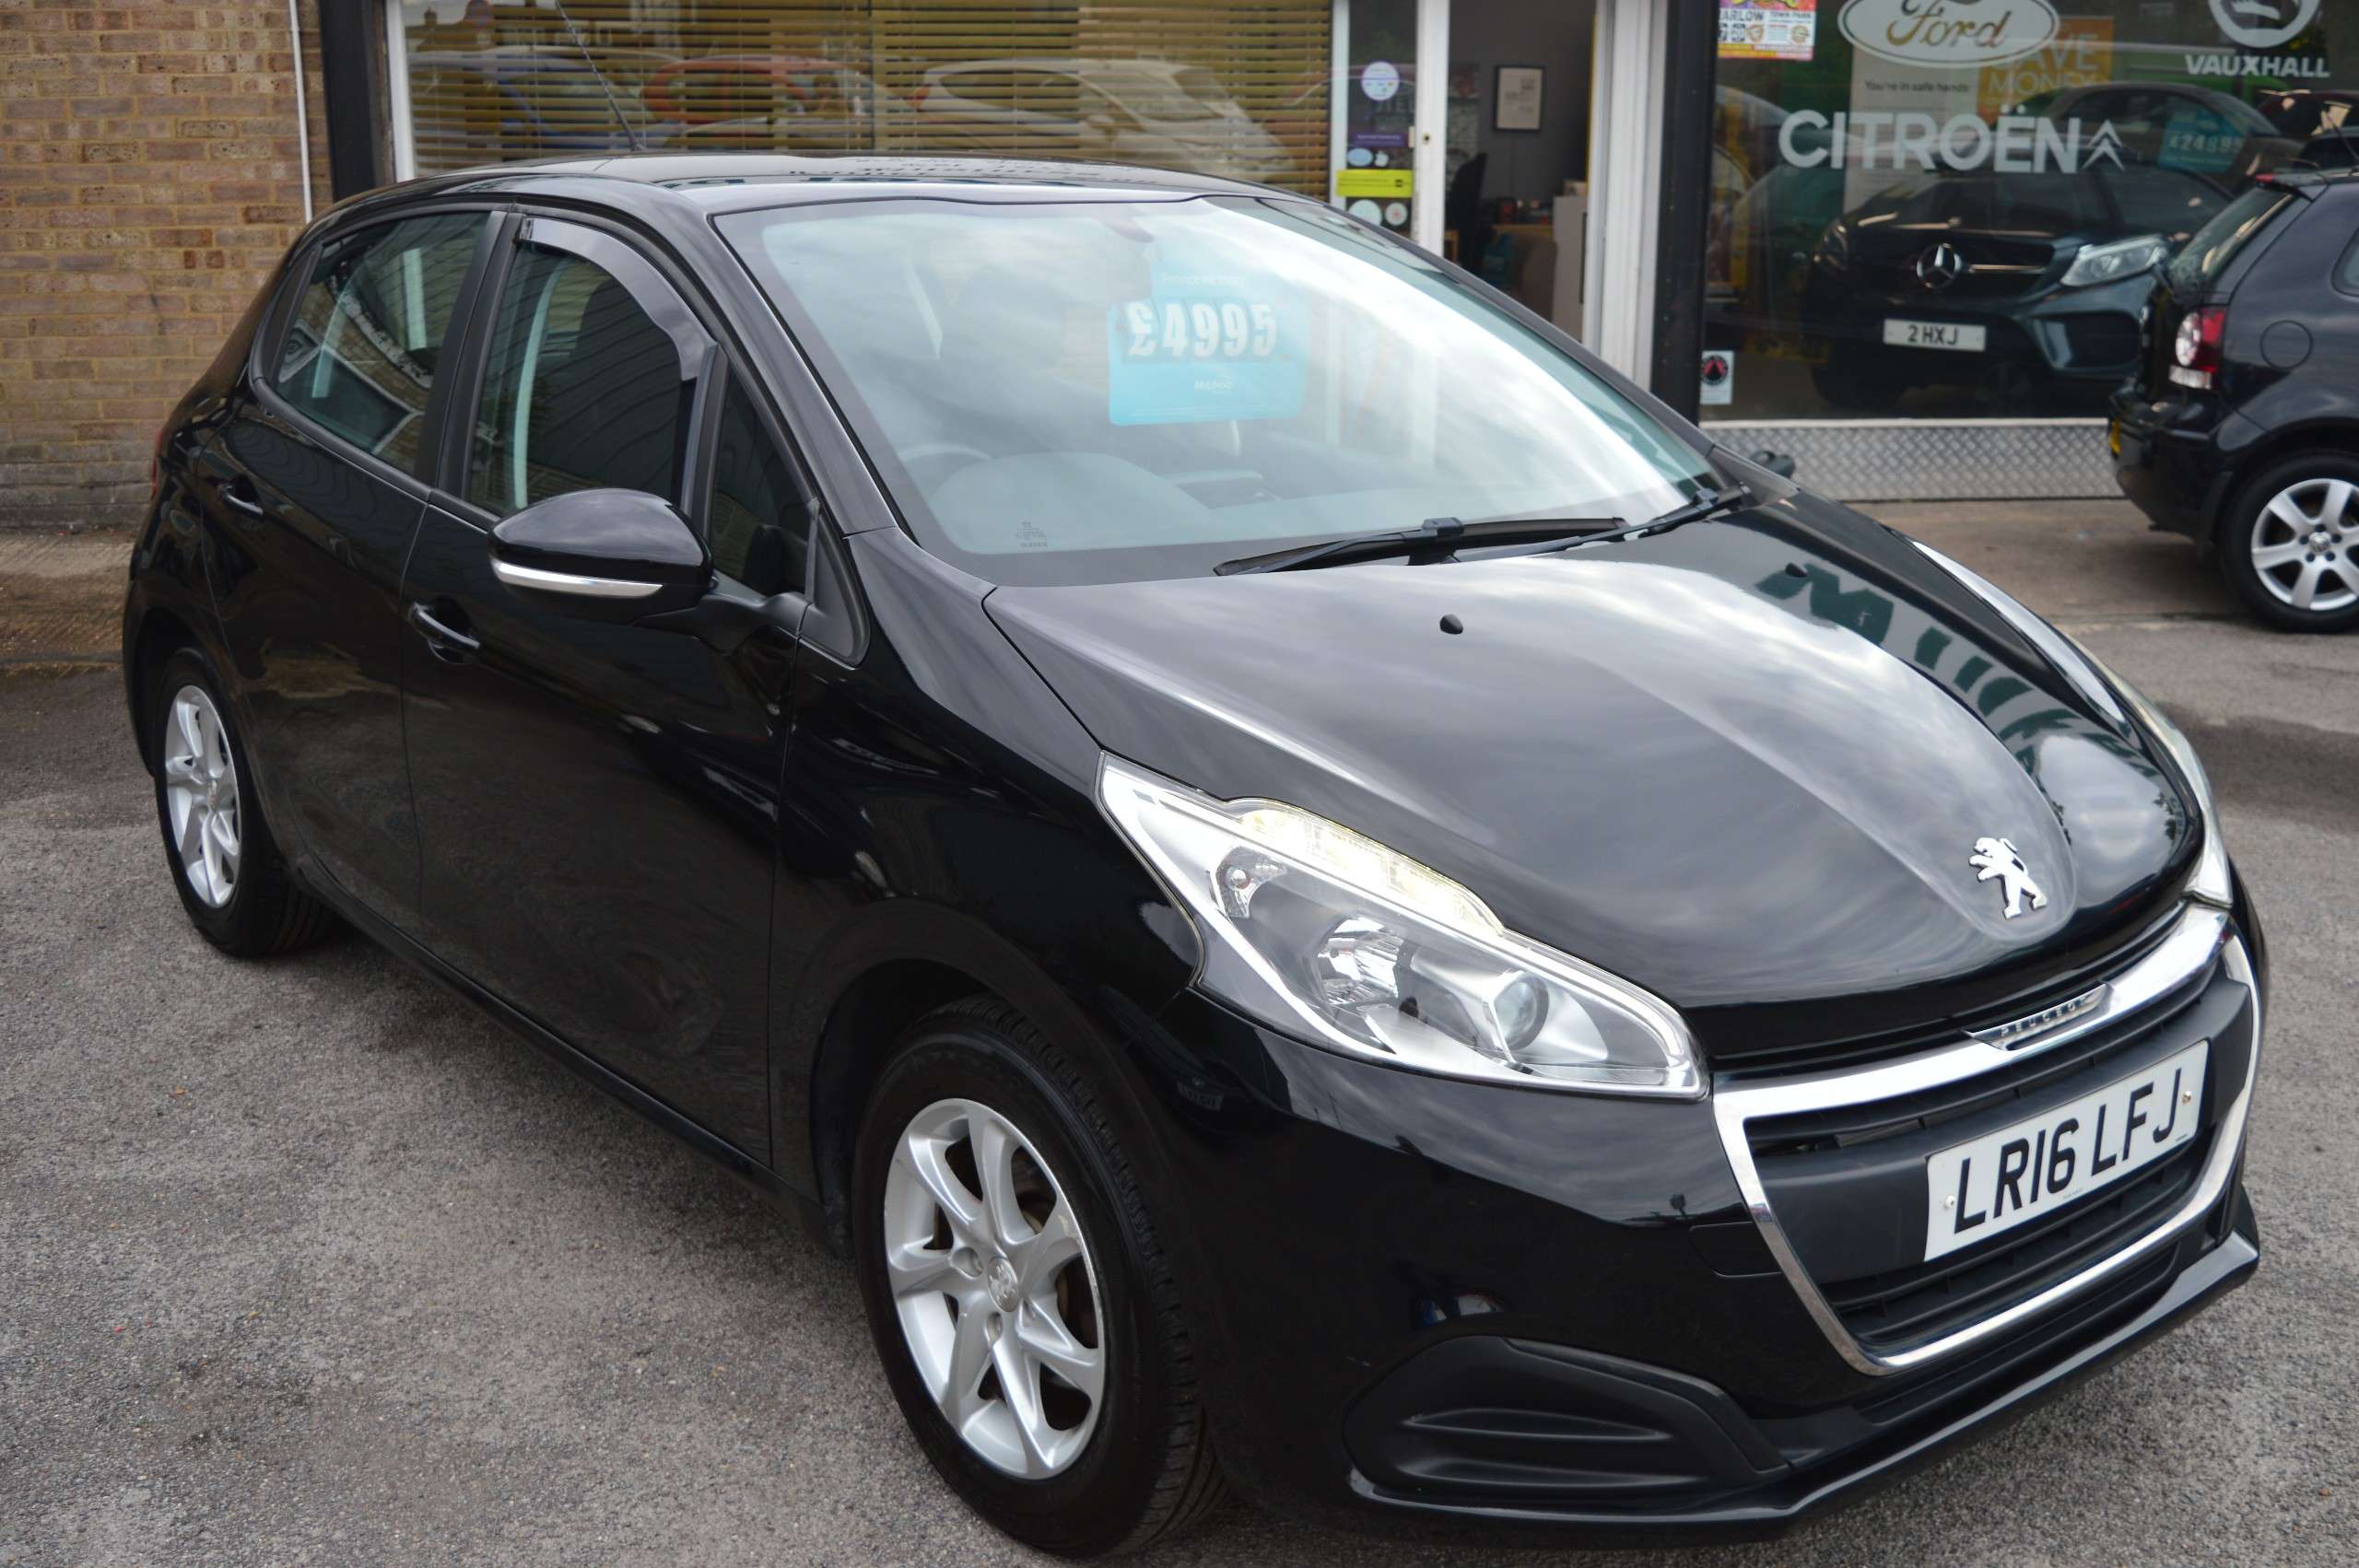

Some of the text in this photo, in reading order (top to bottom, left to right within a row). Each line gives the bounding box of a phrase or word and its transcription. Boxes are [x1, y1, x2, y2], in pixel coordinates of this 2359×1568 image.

[1885, 0, 2013, 47] Ford
[2185, 54, 2330, 77] VAUXHALL
[1778, 104, 2082, 174] CITROËN
[1125, 301, 1277, 357] £4995
[1907, 324, 1959, 345] 2 HXJ
[1954, 1068, 2182, 1235] LR16 LFJ
